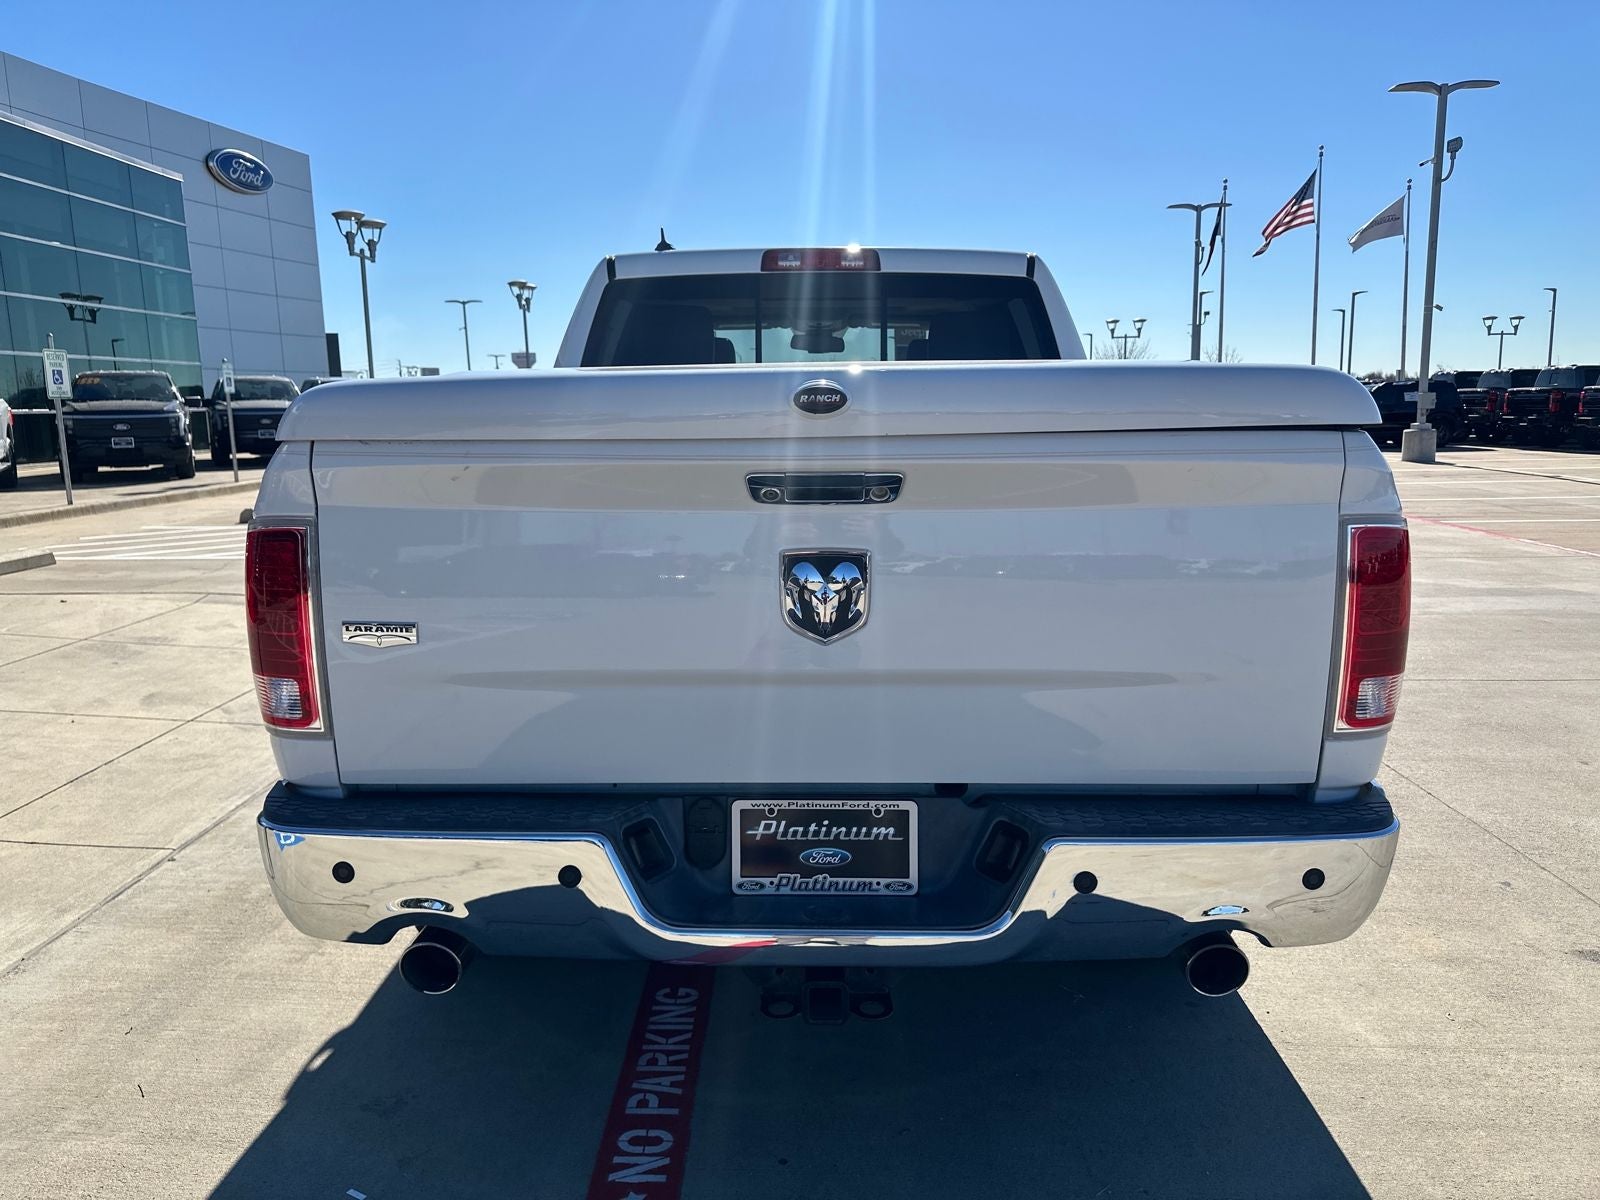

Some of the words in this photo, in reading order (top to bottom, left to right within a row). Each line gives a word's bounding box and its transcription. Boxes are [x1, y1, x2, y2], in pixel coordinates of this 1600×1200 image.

[230, 158, 264, 186] Ford
[799, 394, 841, 403] RANCH
[344, 625, 414, 633] LARAMIE
[750, 801, 900, 809] www.PlatinumFord.com
[745, 819, 904, 841] Platinum
[809, 850, 841, 864] Ford
[773, 873, 881, 892] Platinum
[624, 987, 700, 1116] PARKING
[607, 1129, 674, 1183] NO
